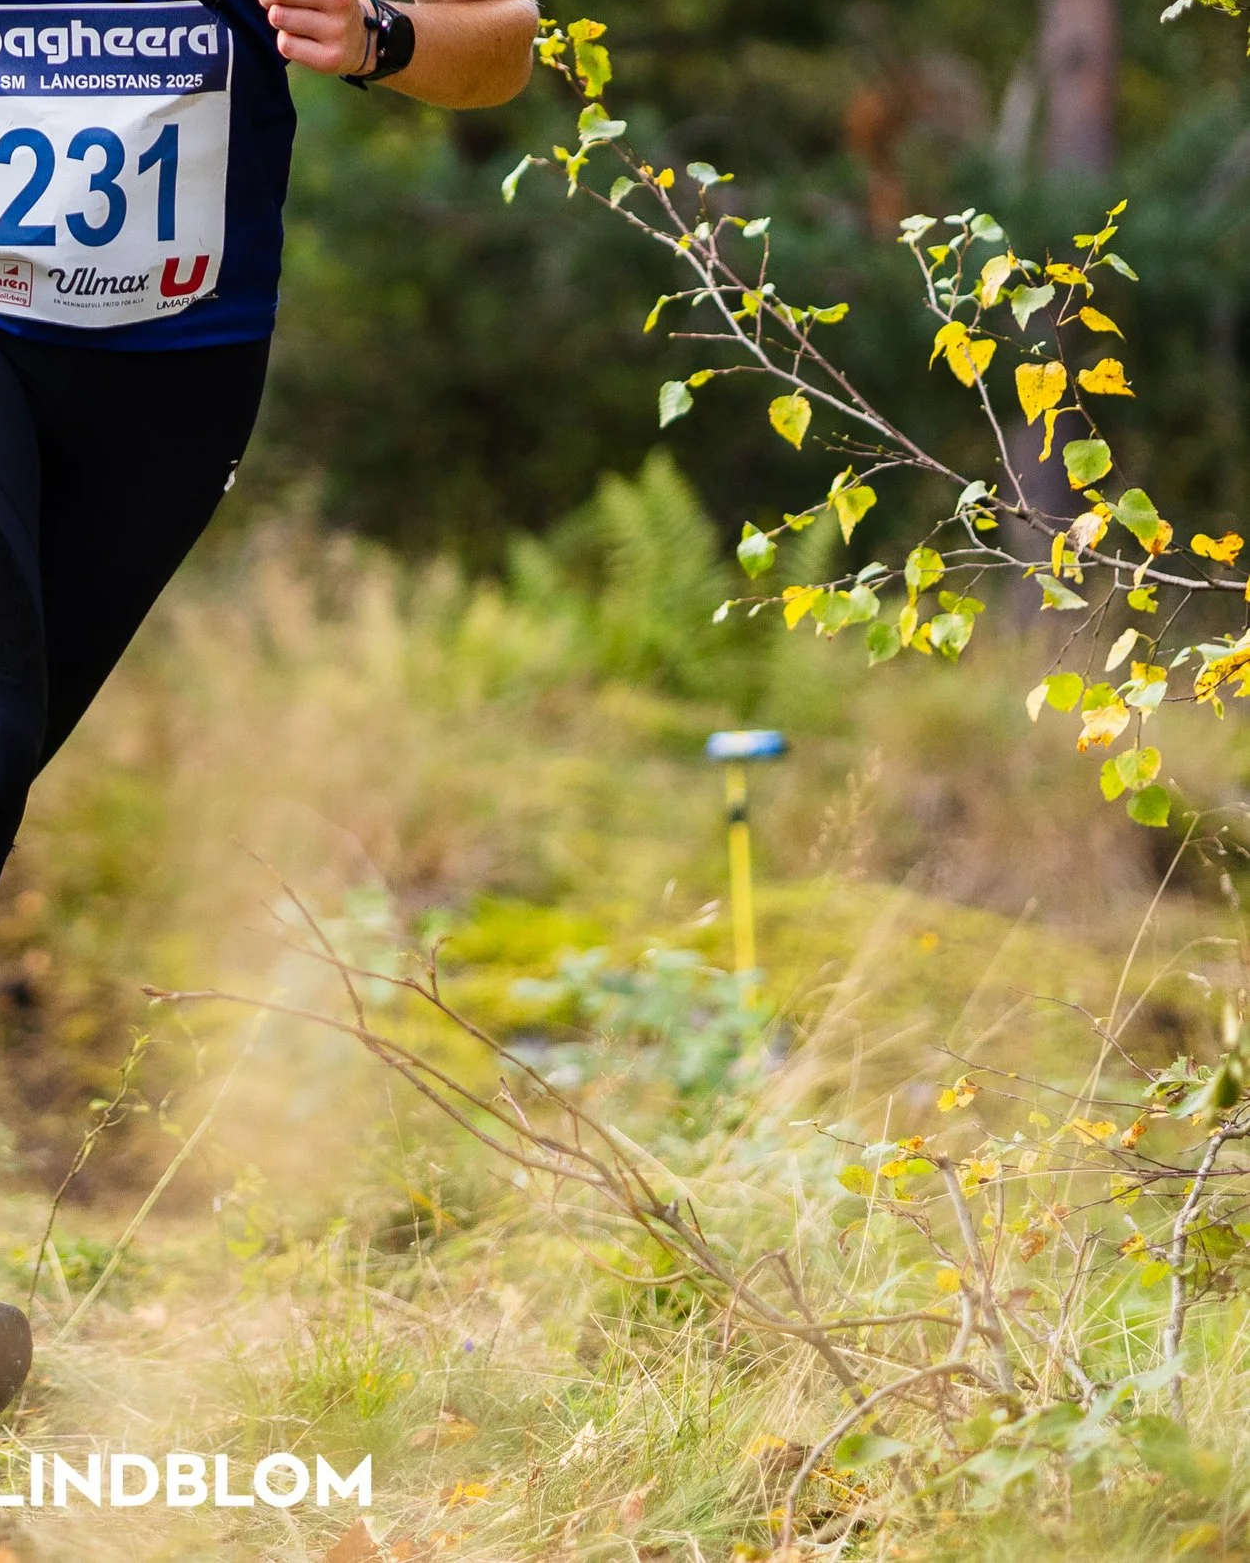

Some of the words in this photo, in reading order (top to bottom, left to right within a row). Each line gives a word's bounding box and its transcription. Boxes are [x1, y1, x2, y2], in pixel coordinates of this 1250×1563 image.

[0, 75, 26, 89] SM
[40, 73, 161, 89] LÅNGDISTANS
[166, 74, 203, 88] 2025
[48, 267, 149, 295] Ullmax
